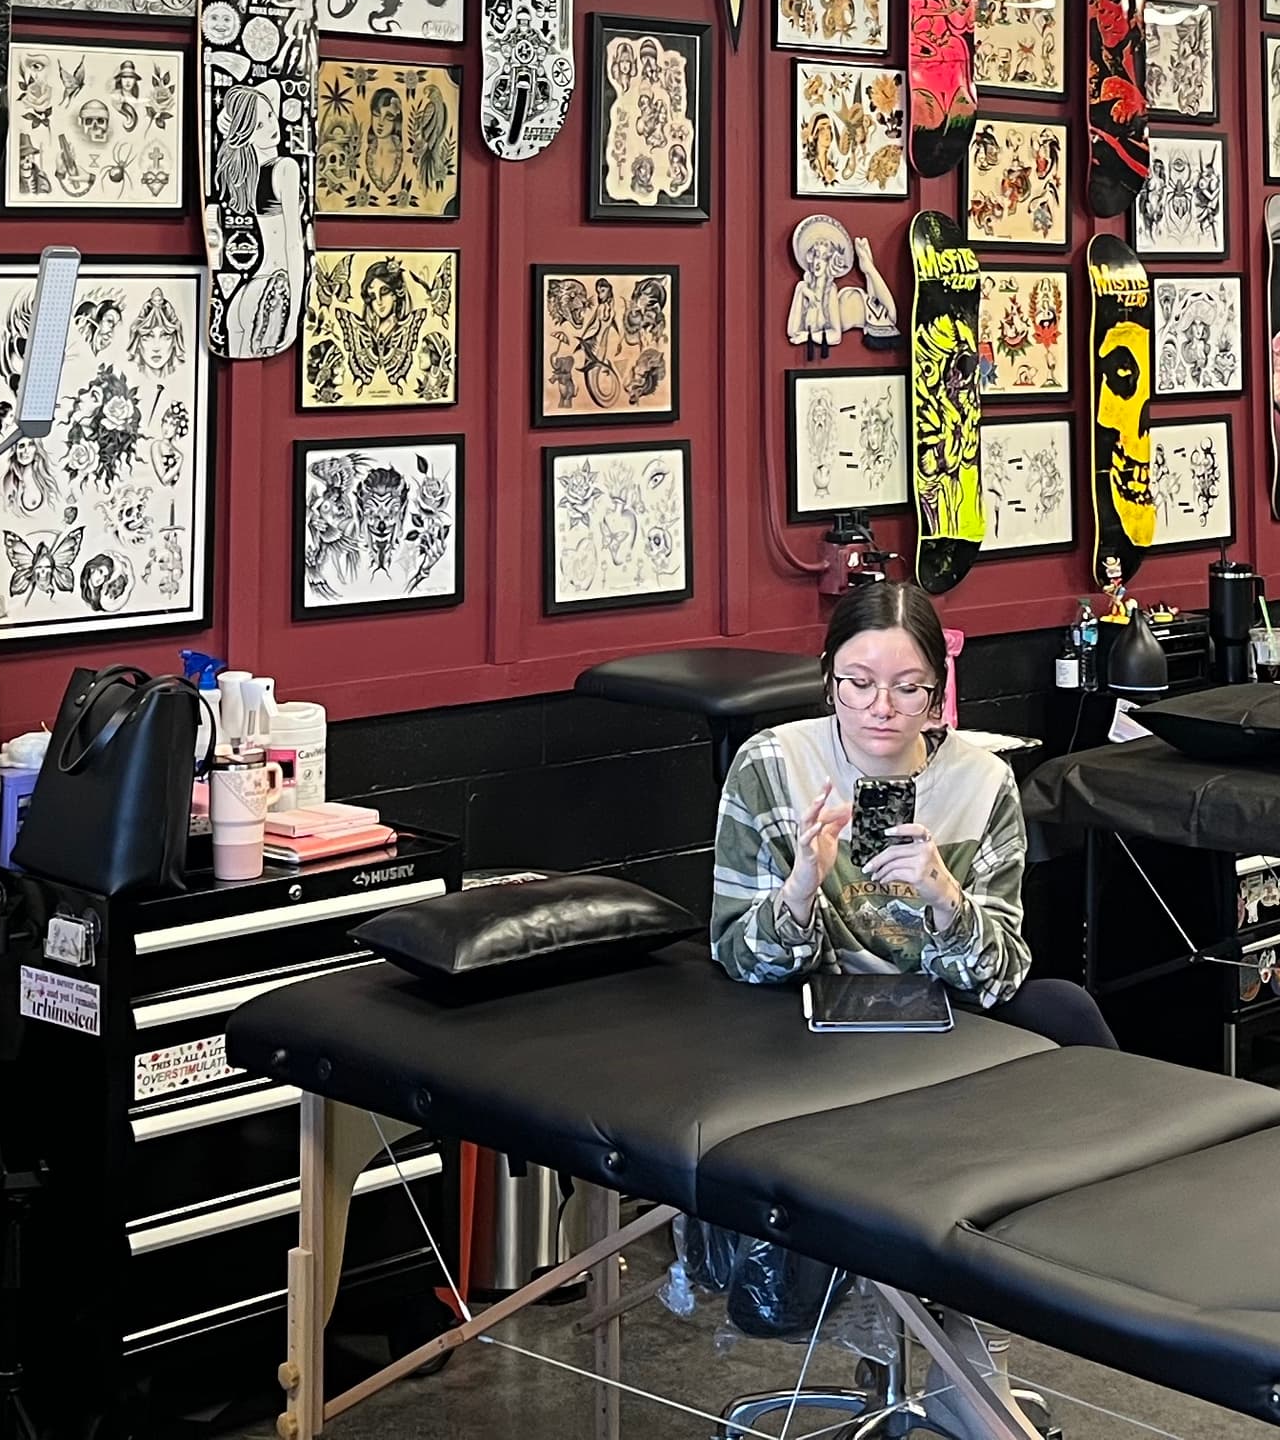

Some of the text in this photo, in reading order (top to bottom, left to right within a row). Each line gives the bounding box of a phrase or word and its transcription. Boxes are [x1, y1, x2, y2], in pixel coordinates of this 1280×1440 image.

[225, 216, 254, 226] 303
[917, 246, 980, 278] MISFITS
[951, 273, 977, 290] ZERO
[1090, 264, 1150, 297] MISFITS
[1124, 292, 1148, 307] ZERO
[371, 863, 415, 883] HUSKY
[22, 967, 98, 998] The pain is never ending
[47, 990, 58, 999] and
[60, 993, 70, 1003] yet
[75, 997, 98, 1010] remain
[32, 998, 98, 1033] whimsical
[151, 1060, 170, 1072] THIS
[173, 1057, 181, 1066] IS
[183, 1053, 198, 1063] ALL
[201, 1050, 207, 1059] A
